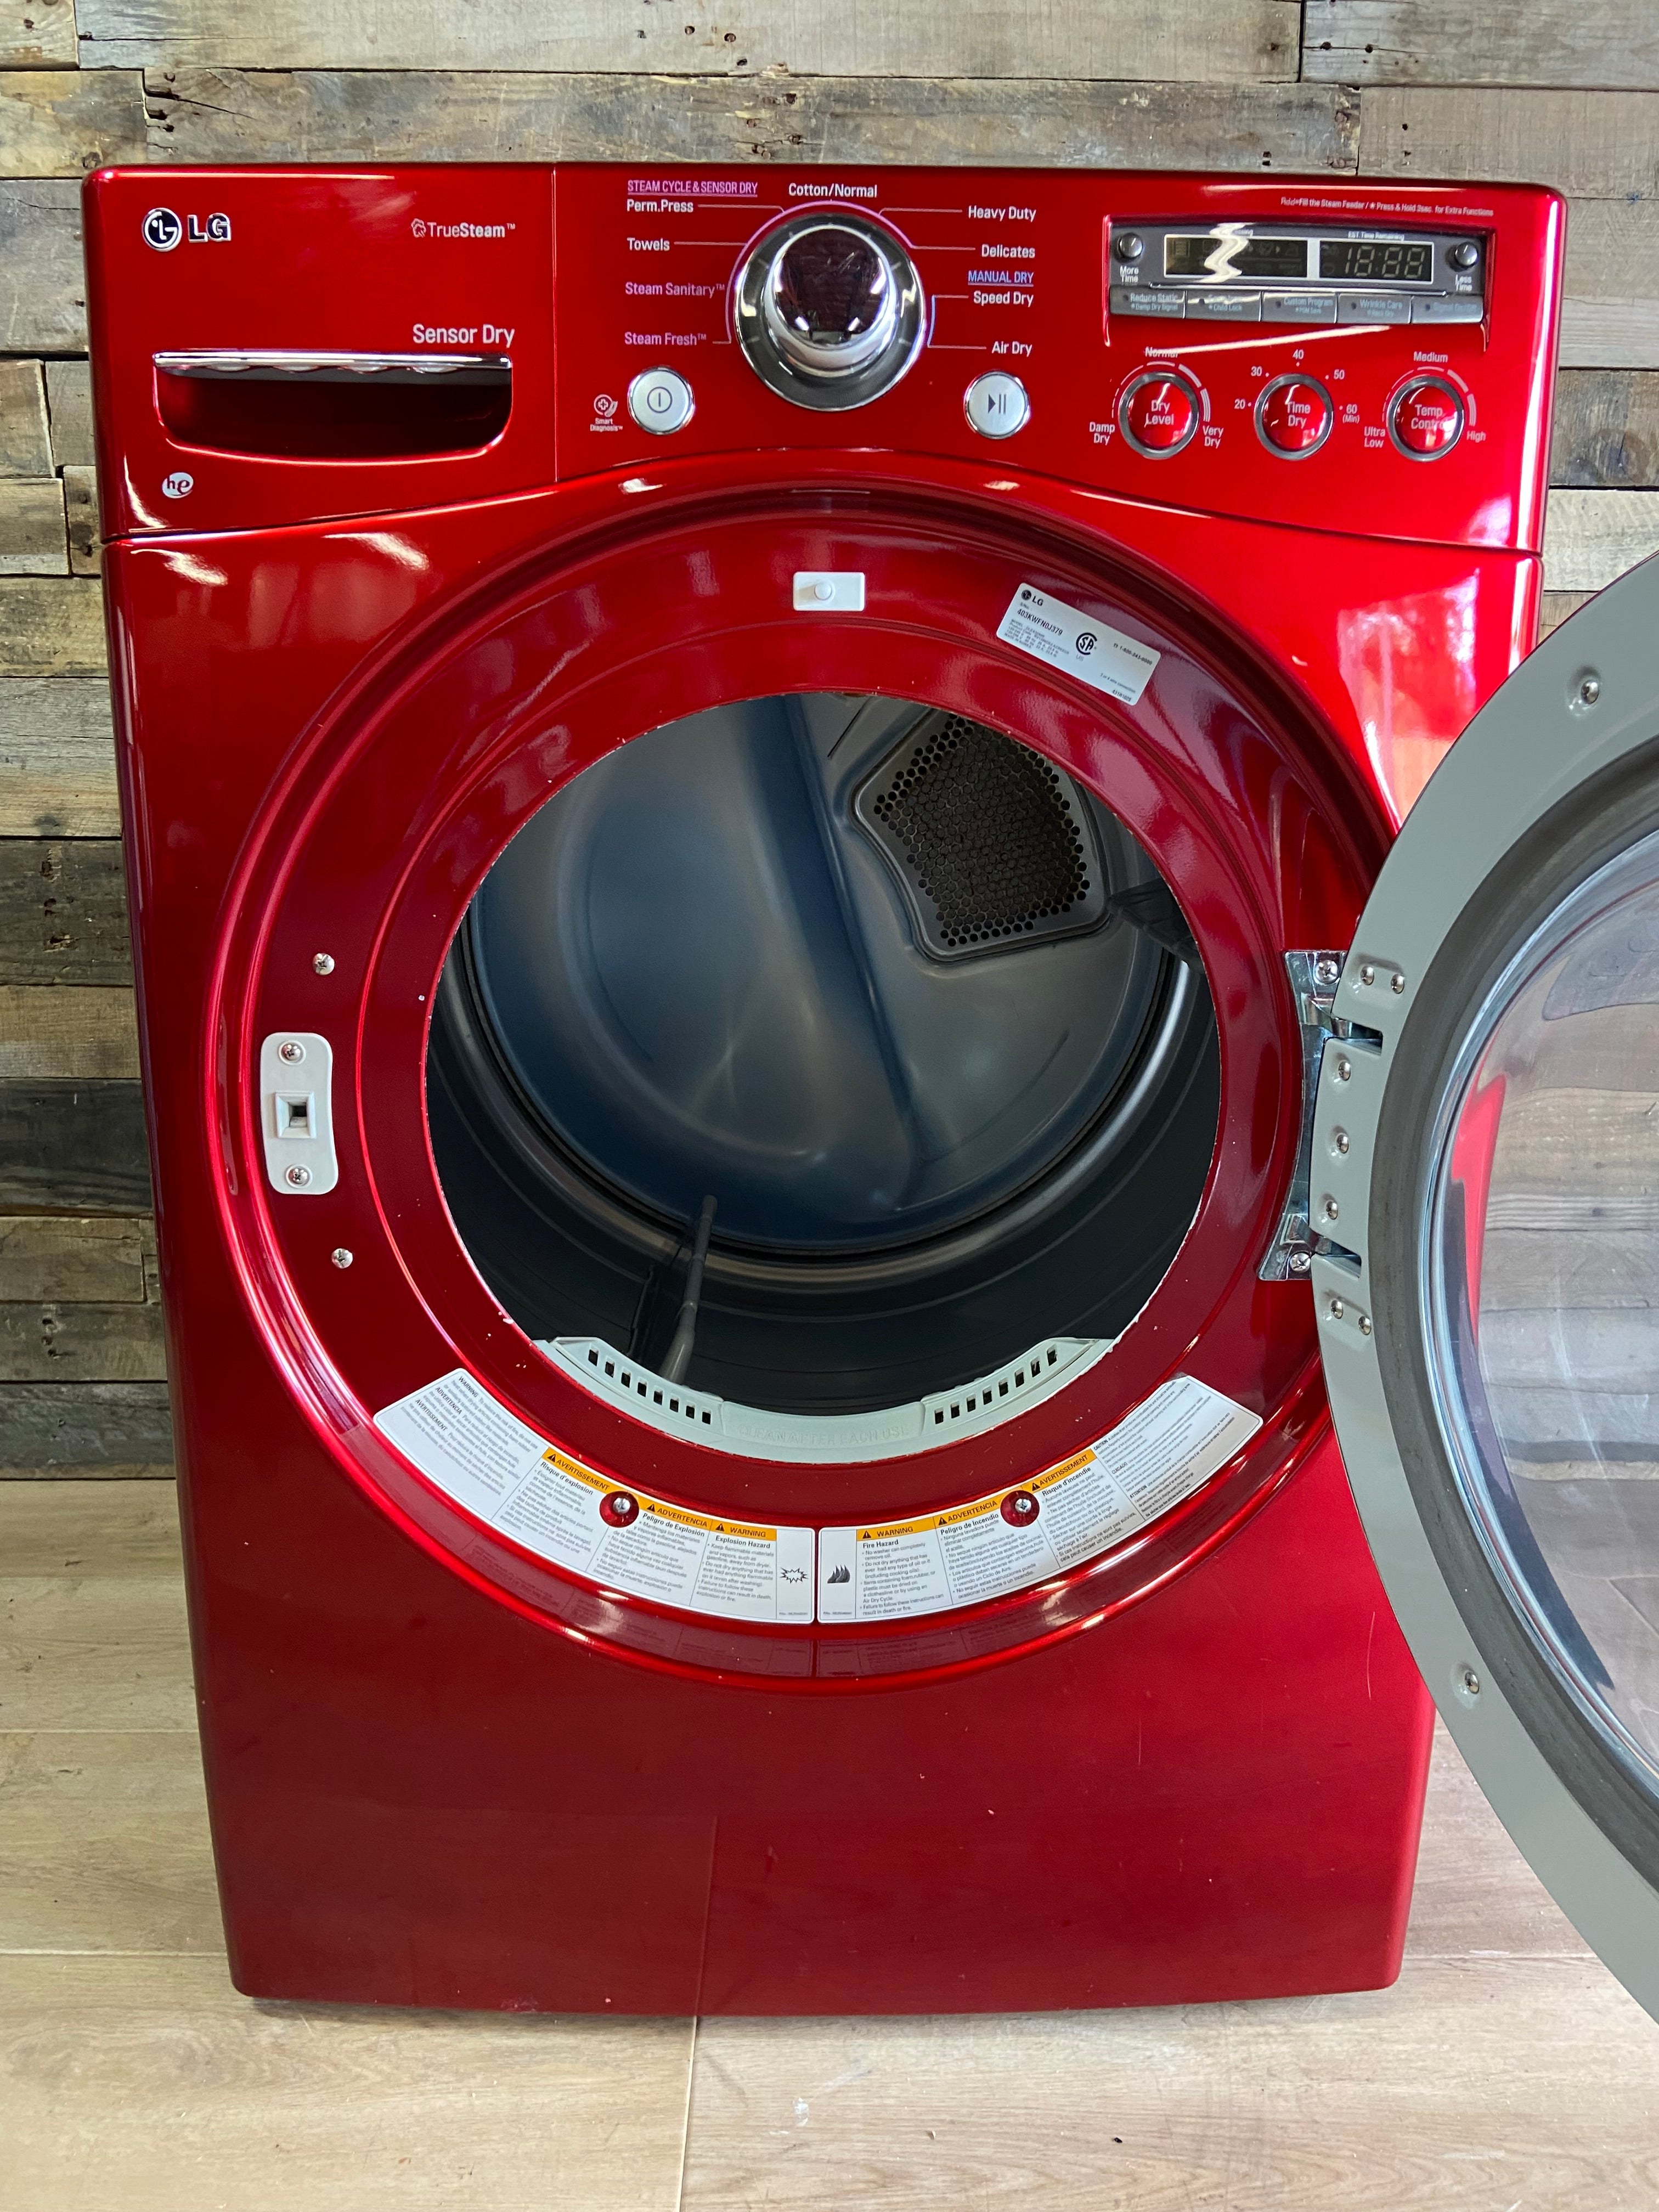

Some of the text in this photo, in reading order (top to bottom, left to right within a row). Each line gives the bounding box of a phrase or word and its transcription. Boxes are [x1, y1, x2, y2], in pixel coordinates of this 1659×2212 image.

[628, 180, 758, 194] STEAM CYCLE & SENSOR DRY
[789, 183, 877, 198] Cotton/Normal
[1321, 199, 1341, 208] Steam
[1377, 202, 1395, 211] Press
[1402, 204, 1416, 212] Hold
[1435, 205, 1444, 213] for
[1445, 206, 1462, 215] Extra
[968, 206, 1036, 222] Heavy Duty
[187, 212, 232, 243] LG
[627, 237, 670, 251] Towels
[981, 244, 1035, 258] Delicates
[968, 270, 1034, 284] MANUAL DRY
[1120, 266, 1139, 275] More
[1121, 274, 1138, 283] Time
[625, 282, 662, 295] Steam
[973, 291, 1034, 307] Speed Dry
[1131, 293, 1178, 302] Reduce Static
[1284, 297, 1333, 308] Custom Program
[1360, 299, 1403, 309] Wrinkle Care
[413, 323, 515, 348] Sensor Dry
[625, 332, 661, 345] Steam
[992, 341, 1032, 357] Air Dry
[1293, 349, 1304, 359] 40
[1414, 351, 1448, 362] Medium
[1251, 366, 1262, 377] 30
[1334, 369, 1345, 380] 50
[1152, 400, 1170, 413] Dry
[1234, 399, 1245, 409] 20
[1287, 402, 1311, 414] Time
[1346, 404, 1357, 414] 60
[1414, 404, 1443, 419] Temp
[1147, 413, 1174, 425] Level
[1288, 415, 1306, 428] Dry
[1342, 415, 1359, 424] (Min)
[1411, 417, 1446, 430] Contro
[1090, 422, 1115, 433] Damp
[1203, 426, 1223, 437] Very
[1364, 426, 1386, 437] Ultra
[1093, 434, 1110, 445] Dry
[1205, 437, 1221, 449] Dry
[1364, 437, 1384, 448] Low
[1466, 431, 1486, 443] High
[1032, 596, 1044, 606] LG
[459, 1376, 478, 1397] WARNING
[436, 1387, 462, 1414] ADVERTENCIA
[416, 1399, 447, 1431] AVERTISSEMENT
[541, 1462, 560, 1477] Risque
[556, 1459, 610, 1491] AVERTISSEMENT
[1039, 1454, 1088, 1486] AVERTISSEMENT
[1042, 1482, 1063, 1497] Risque
[657, 1508, 708, 1527] ADVERTENCIA
[948, 1500, 997, 1522] ADVERTENCIA
[643, 1513, 664, 1525] Peligro
[675, 1523, 705, 1537] Explosión
[941, 1525, 962, 1536] Peligro
[973, 1513, 998, 1526] Incendio
[730, 1527, 766, 1537] WARNING
[877, 1527, 913, 1537] WARNING
[716, 1536, 746, 1546] Explosion
[877, 1539, 899, 1548] Hazard
